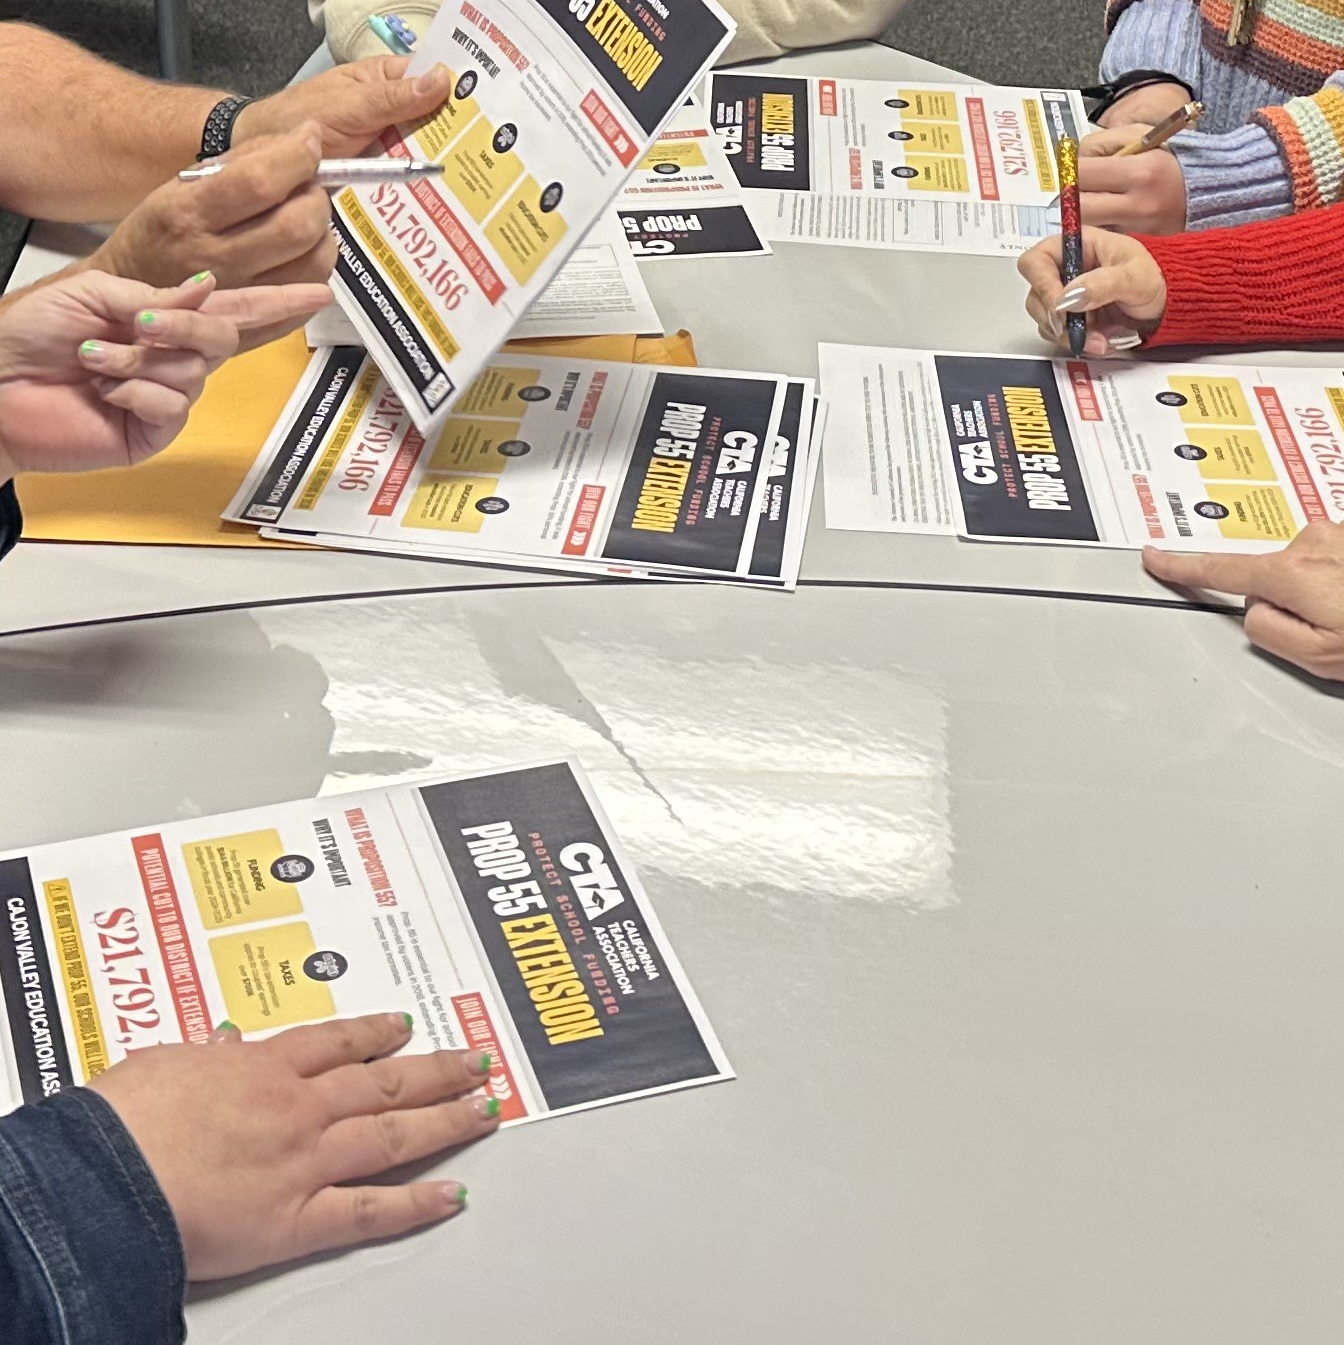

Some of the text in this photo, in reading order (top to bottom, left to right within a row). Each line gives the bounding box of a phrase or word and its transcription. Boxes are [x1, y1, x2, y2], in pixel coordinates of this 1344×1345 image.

[633, 3, 667, 42] FUNDING
[761, 145, 795, 172] PROP
[1002, 109, 1030, 177] $21,792,166
[369, 181, 471, 312] $21,792,166
[641, 214, 702, 232] PROP
[341, 245, 398, 328] VALLEY EDUCATION
[266, 365, 350, 505] CAJON VALLEY EDUCATION ASSOCIATION
[705, 417, 722, 453] PROTECT
[716, 430, 758, 475] CTA
[1001, 386, 1072, 511] PROP 55 EXTENSION
[631, 401, 707, 533] PROP 55 EXTENSION
[958, 440, 999, 485] CTA
[1001, 456, 1019, 498] PROTECT
[730, 480, 748, 517] CALIFORNIA
[312, 818, 333, 836] WHY
[318, 833, 338, 851] IT'S
[247, 858, 266, 892] FUNDING
[344, 807, 398, 908] WHAT IS PROPOSITION 55?
[560, 842, 625, 921] CTA
[140, 847, 197, 995] POTENTIAL CUT TO OUR DISTRICT IF
[460, 820, 605, 1046] PROP 55 EXTENSION
[527, 831, 620, 1015] PROTECT SCHOOL FUNDING
[278, 959, 296, 986] TAXES
[592, 925, 635, 996] ASSOCIATION
[607, 922, 640, 973] TEACHERS
[622, 919, 659, 981] CALIFORNIA
[7, 897, 57, 1072] CAJON VALLEY EDUCATION
[76, 1007, 99, 1042] SCHOOLS
[456, 997, 492, 1041] JOIN OUR
